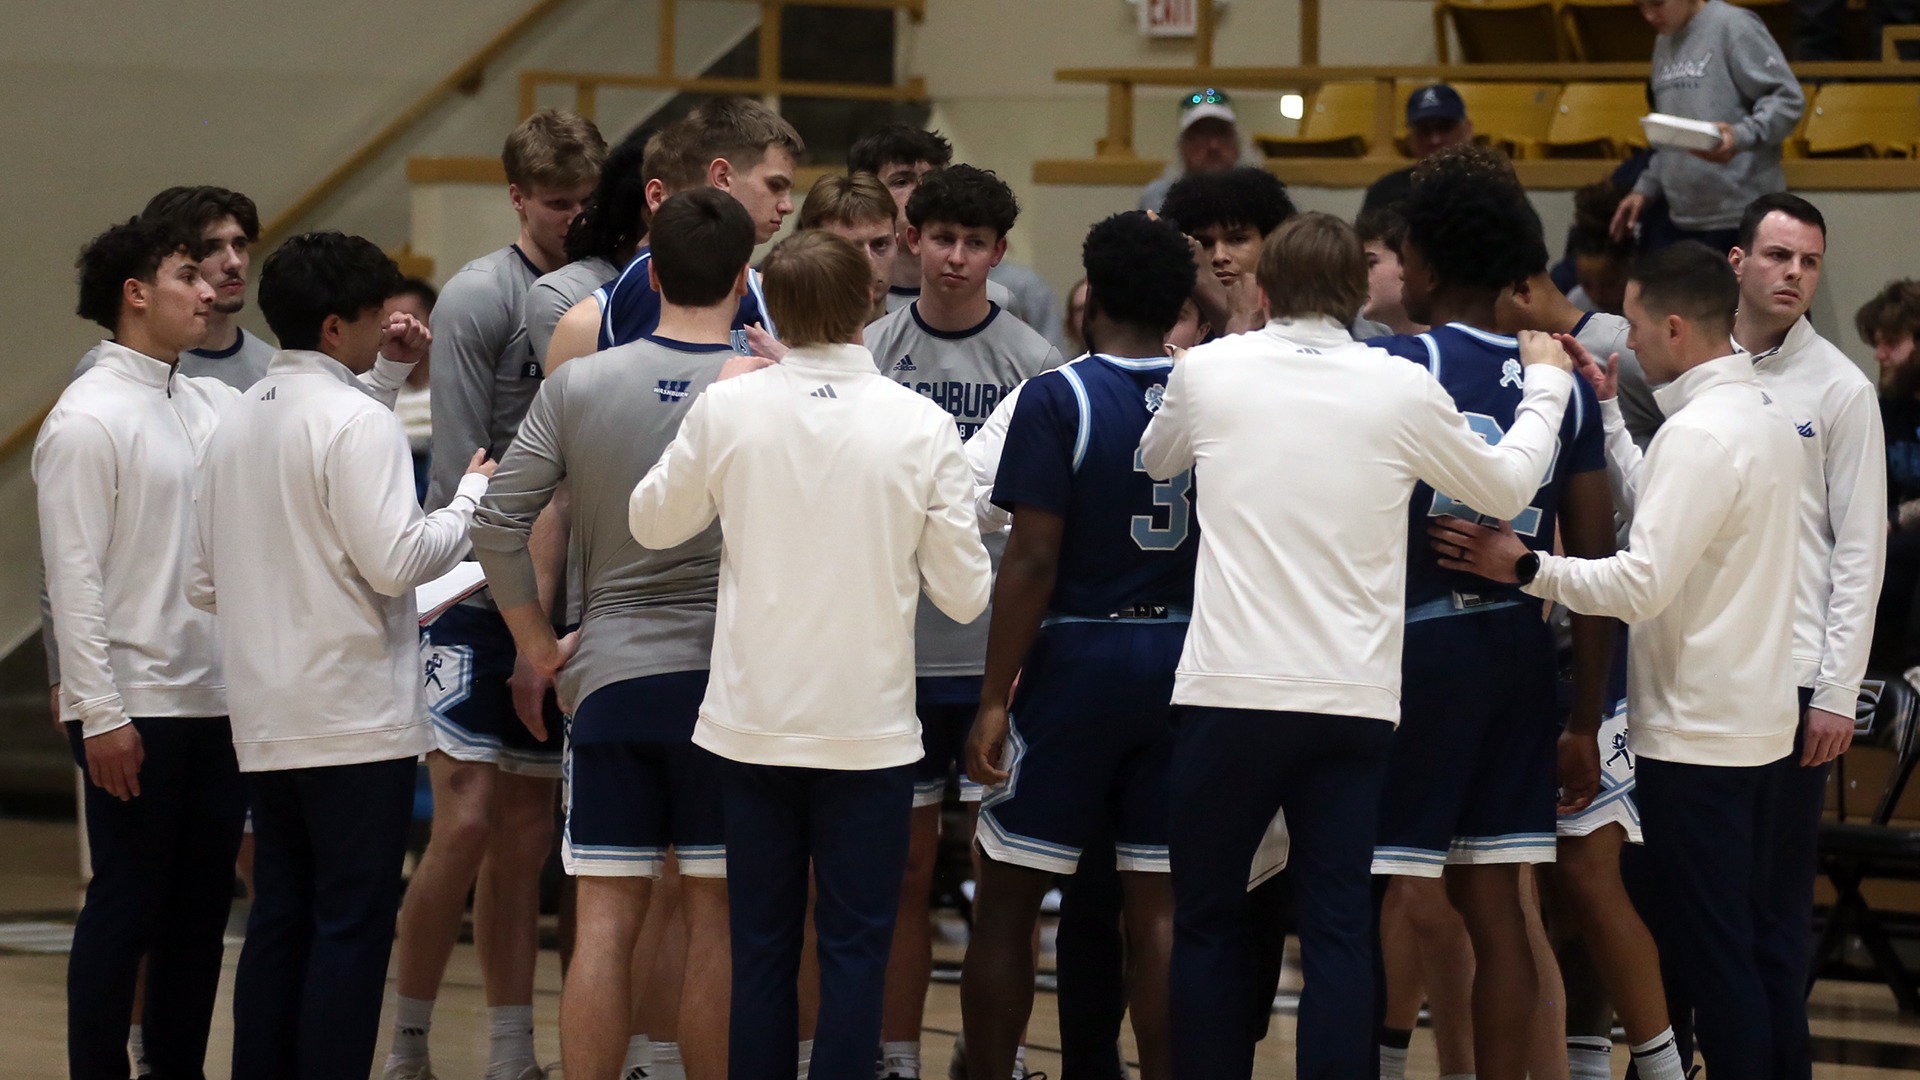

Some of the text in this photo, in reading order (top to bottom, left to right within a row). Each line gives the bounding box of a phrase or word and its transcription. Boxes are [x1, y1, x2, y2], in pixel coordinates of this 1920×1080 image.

[653, 387, 689, 398] WASHBURN
[897, 381, 1016, 418] HBUR
[1130, 446, 1193, 551] 3
